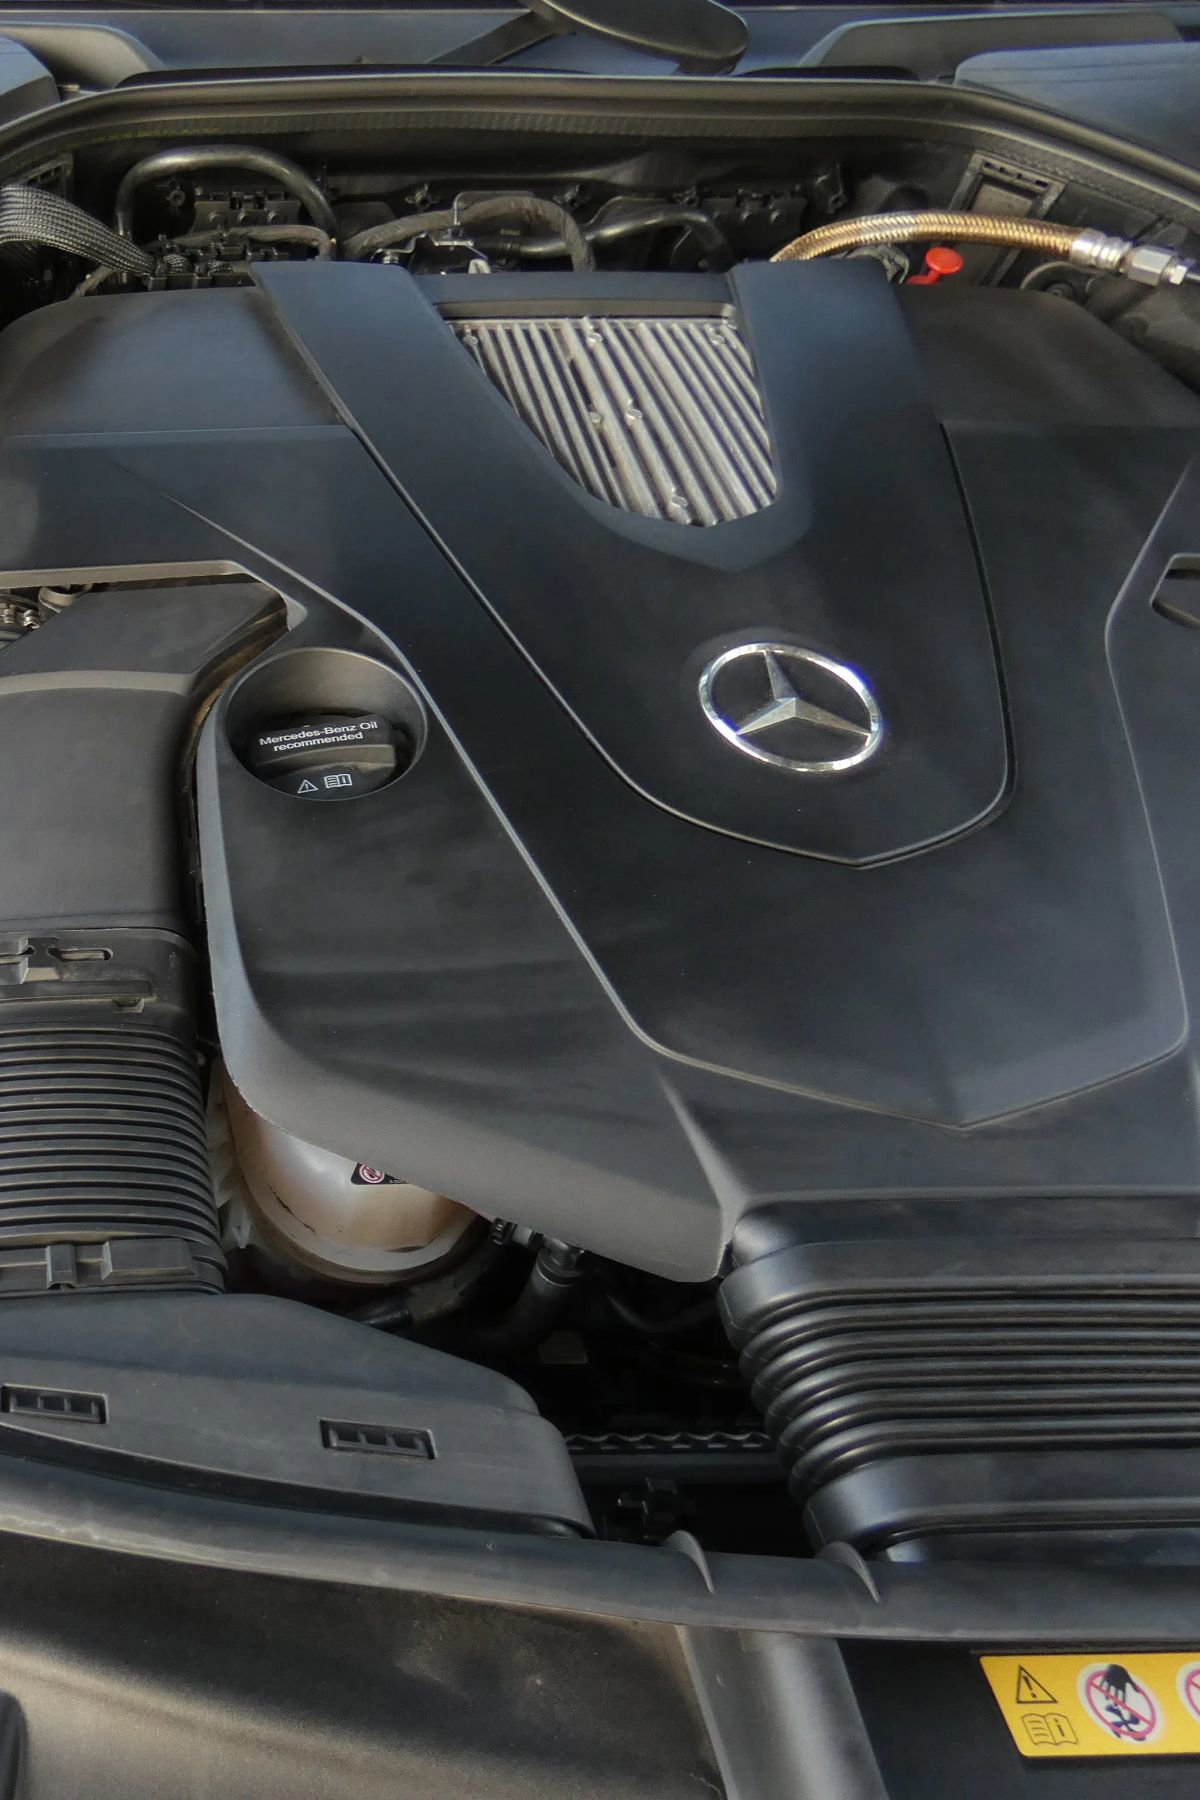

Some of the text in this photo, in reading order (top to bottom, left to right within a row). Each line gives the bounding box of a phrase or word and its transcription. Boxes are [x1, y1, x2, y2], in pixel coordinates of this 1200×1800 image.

[259, 721, 378, 746] Mercedes-Benz Oil
[273, 732, 363, 752] recommended
